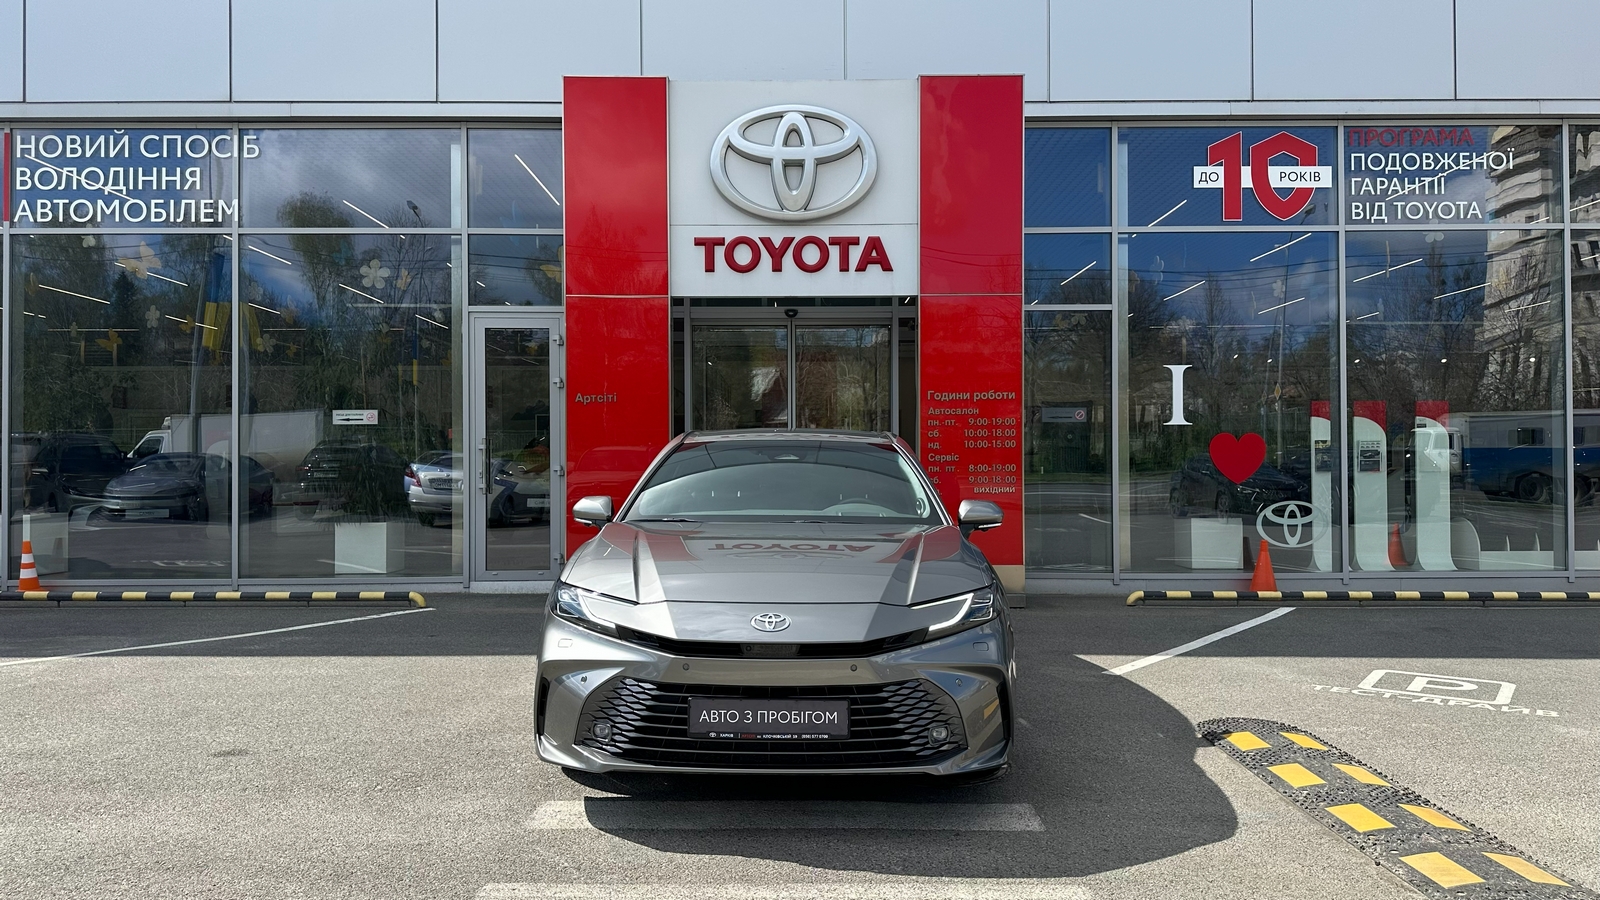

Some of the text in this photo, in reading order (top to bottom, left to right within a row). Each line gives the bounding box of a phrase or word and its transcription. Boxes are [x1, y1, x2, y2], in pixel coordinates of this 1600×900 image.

[16, 129, 260, 158] НОВИЙ СПОСІБ
[1349, 128, 1475, 147] ПРОГРАМА
[1351, 148, 1515, 174] ПОДОВЖЕНОЇ
[16, 166, 201, 195] ВОЛОДІННЯ
[1198, 171, 1220, 184] ДО
[1279, 171, 1321, 182] РОКІВ
[1351, 173, 1446, 195] ГАРАНТІЇ
[13, 199, 239, 223] АВТОМОБІЛЕМ
[1351, 201, 1483, 223] ВІД TOYOTA
[694, 235, 894, 274] TOYOTA
[575, 392, 617, 405] Артсіті
[927, 390, 1016, 402] Години роботи
[1162, 364, 1193, 425] I
[928, 407, 979, 415] Автосалон
[968, 417, 1016, 426] 9:00-19:00
[927, 428, 1016, 437] сб. 10:00-18:00
[963, 440, 1016, 448] 10:00-15:00
[928, 453, 960, 462] Сервіс
[968, 464, 1017, 472] 8:00-19:00
[973, 485, 1016, 494] вихідний
[1405, 676, 1479, 692] P
[699, 710, 838, 724] АВТО З ПРОБІГОМ
